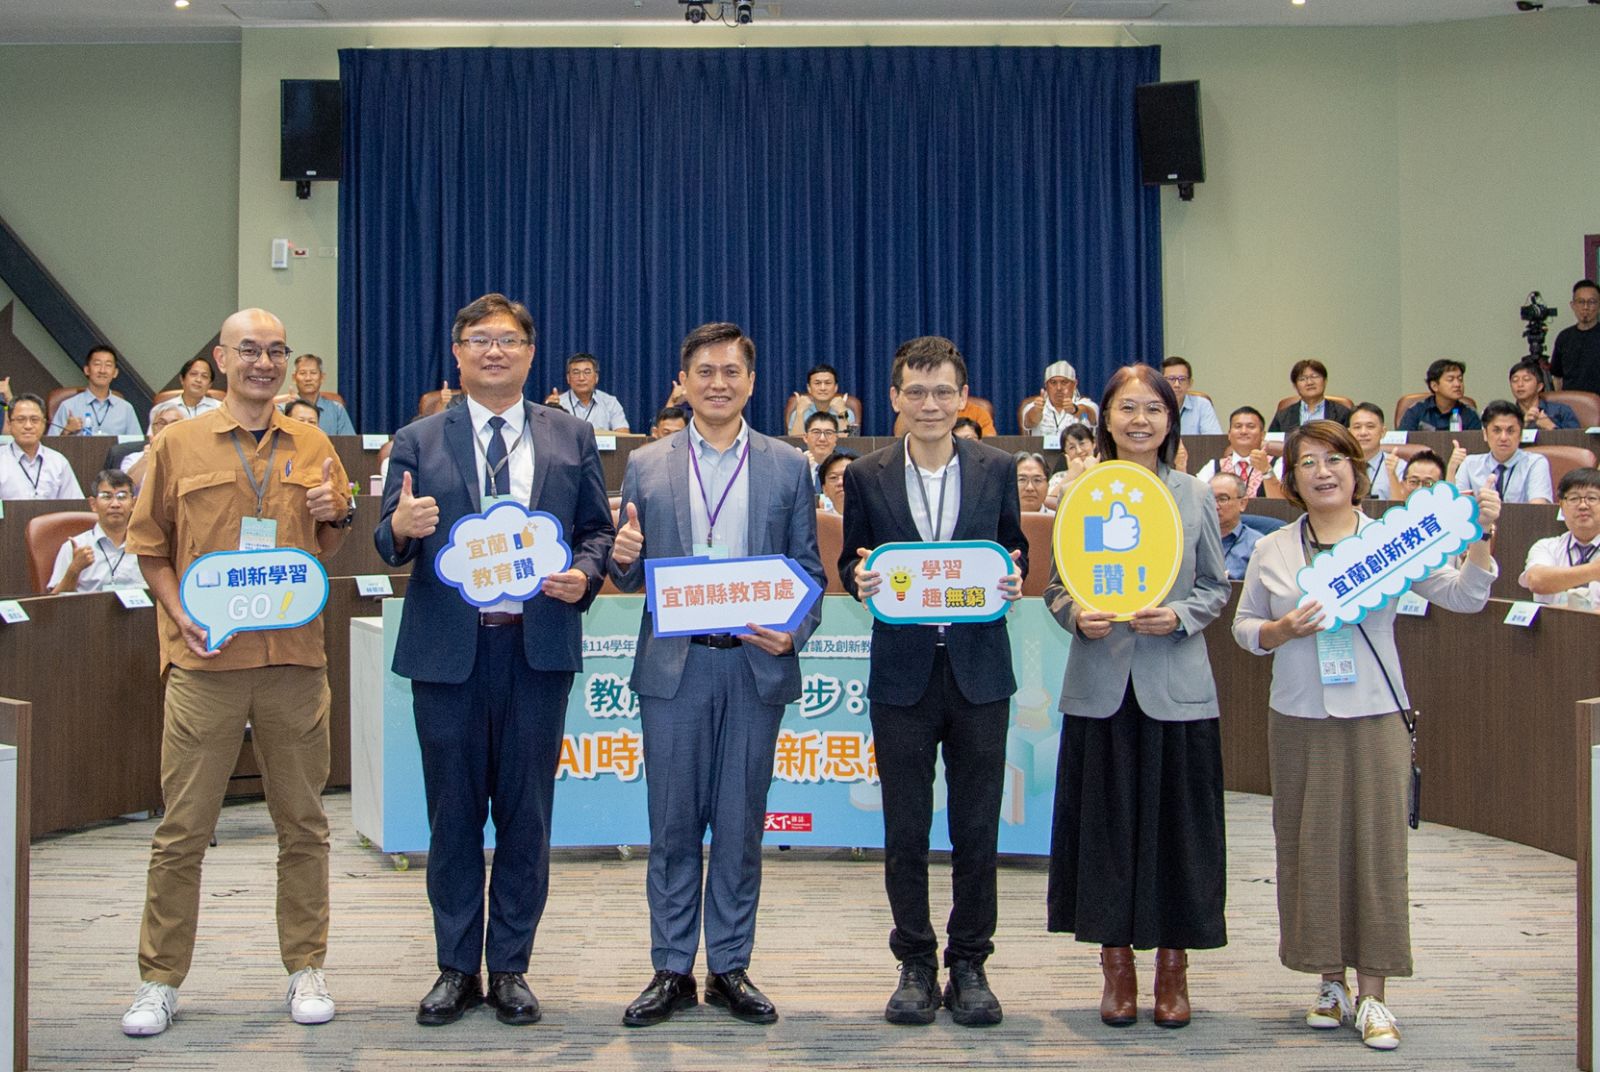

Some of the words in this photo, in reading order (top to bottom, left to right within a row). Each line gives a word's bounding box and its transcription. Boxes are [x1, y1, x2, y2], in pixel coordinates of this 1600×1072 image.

[466, 533, 508, 560] 宜蘭
[1328, 513, 1442, 599] 宜蘭創新教育
[226, 564, 308, 588] 創新學習
[471, 557, 535, 589] 教育讚
[921, 559, 962, 580] 學習
[661, 578, 796, 609] 宜蘭縣教育處
[921, 586, 986, 608] 趣無窮
